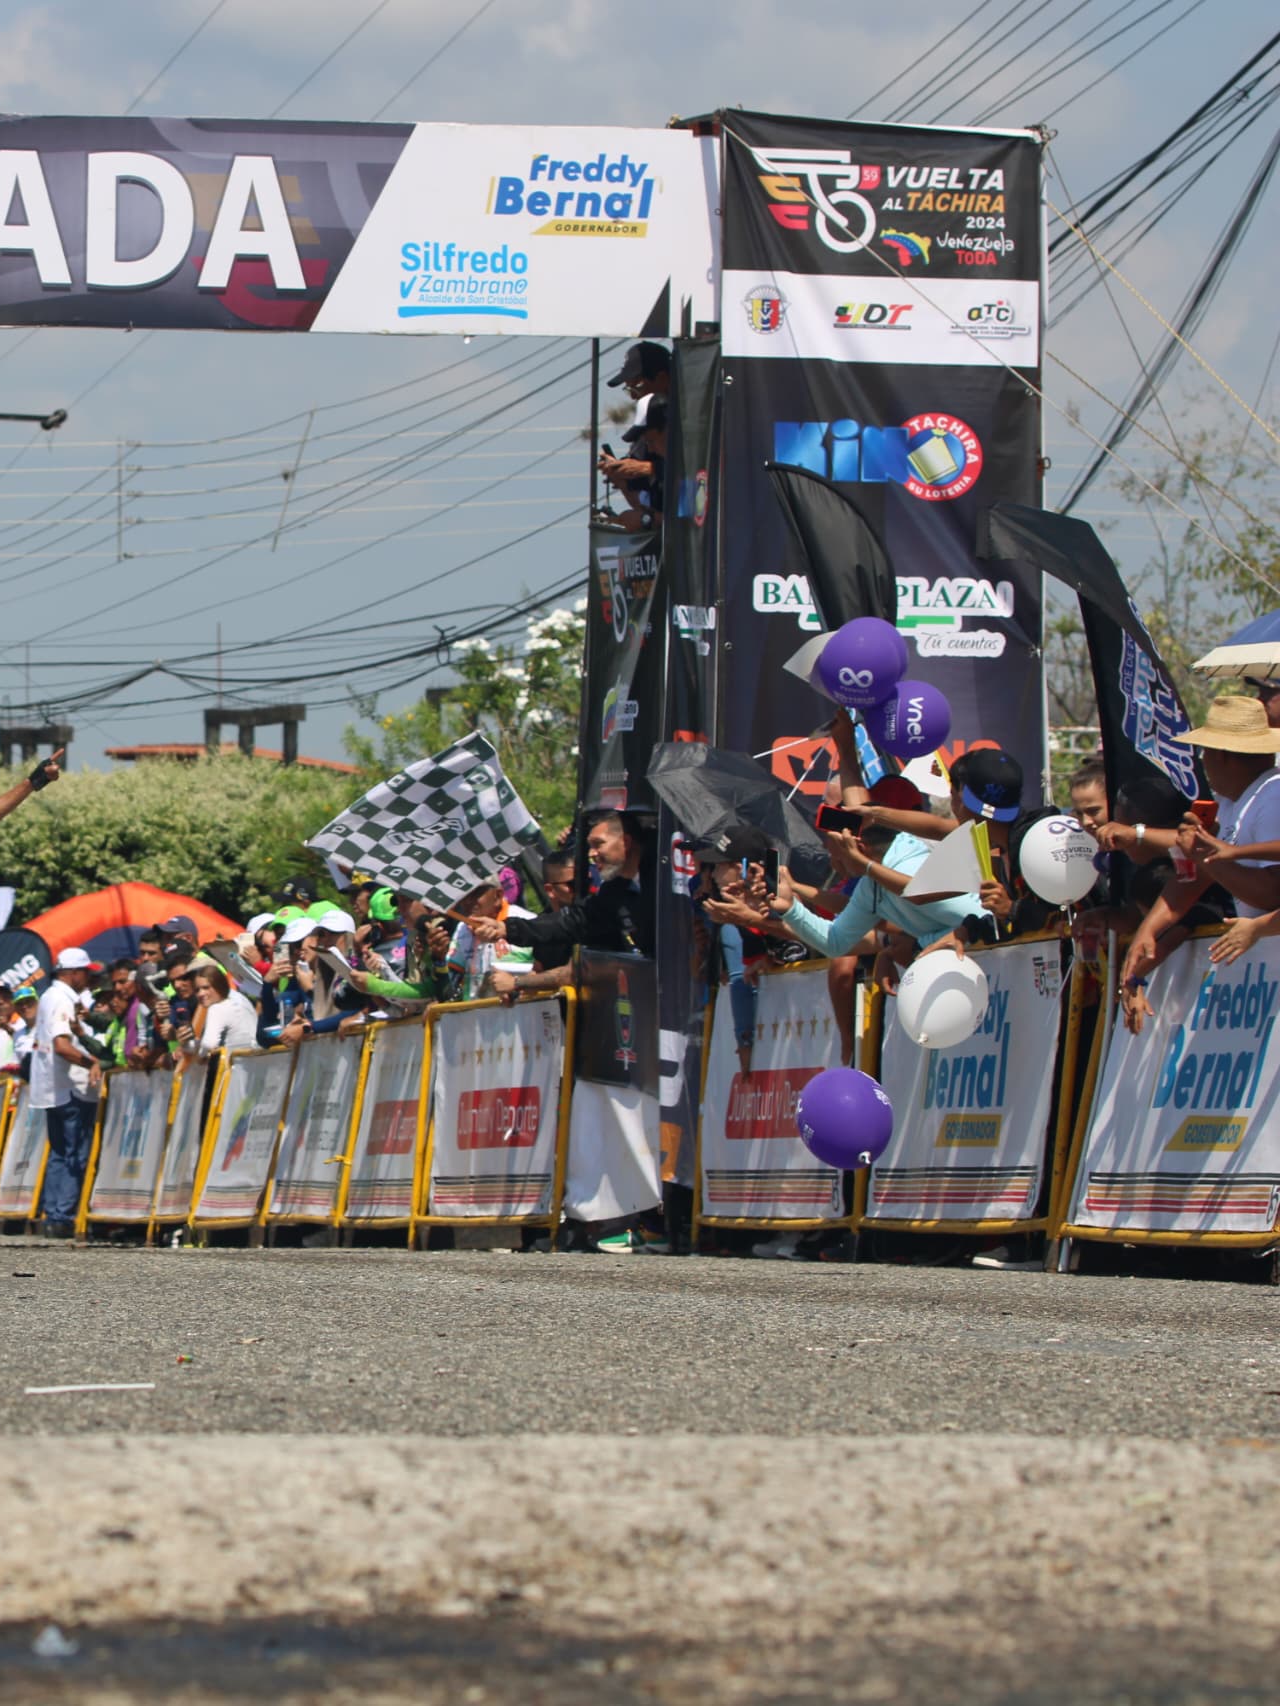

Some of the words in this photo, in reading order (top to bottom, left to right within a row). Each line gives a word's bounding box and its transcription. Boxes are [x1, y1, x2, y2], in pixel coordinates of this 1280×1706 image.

[529, 153, 648, 188] Freddy
[863, 170, 879, 181] 59
[887, 166, 1005, 190] VUELTA
[494, 176, 655, 219] Bernal
[881, 197, 904, 211] AL
[906, 189, 1006, 213] TÁCHIRA
[554, 223, 639, 234] GOBERNADOR
[965, 216, 1006, 229] 2024
[400, 241, 528, 274] Silfredo
[954, 250, 998, 265] TODA
[418, 274, 528, 294] Zambrano
[909, 416, 980, 464] TACHIRA
[908, 482, 922, 495] SU
[925, 475, 972, 498] LOTERIA
[897, 584, 997, 609] PLAZA
[948, 636, 1000, 651] cuentas
[906, 696, 926, 745] vnet
[1191, 961, 1279, 1038] Freddy
[924, 1022, 1011, 1109] Bernal
[1151, 1015, 1276, 1110] Bernal
[727, 1083, 774, 1121] Juventud
[496, 1097, 538, 1136] Deporte
[944, 1120, 998, 1140] GOBERNADOR
[1184, 1122, 1242, 1144] GOBERNADOR
